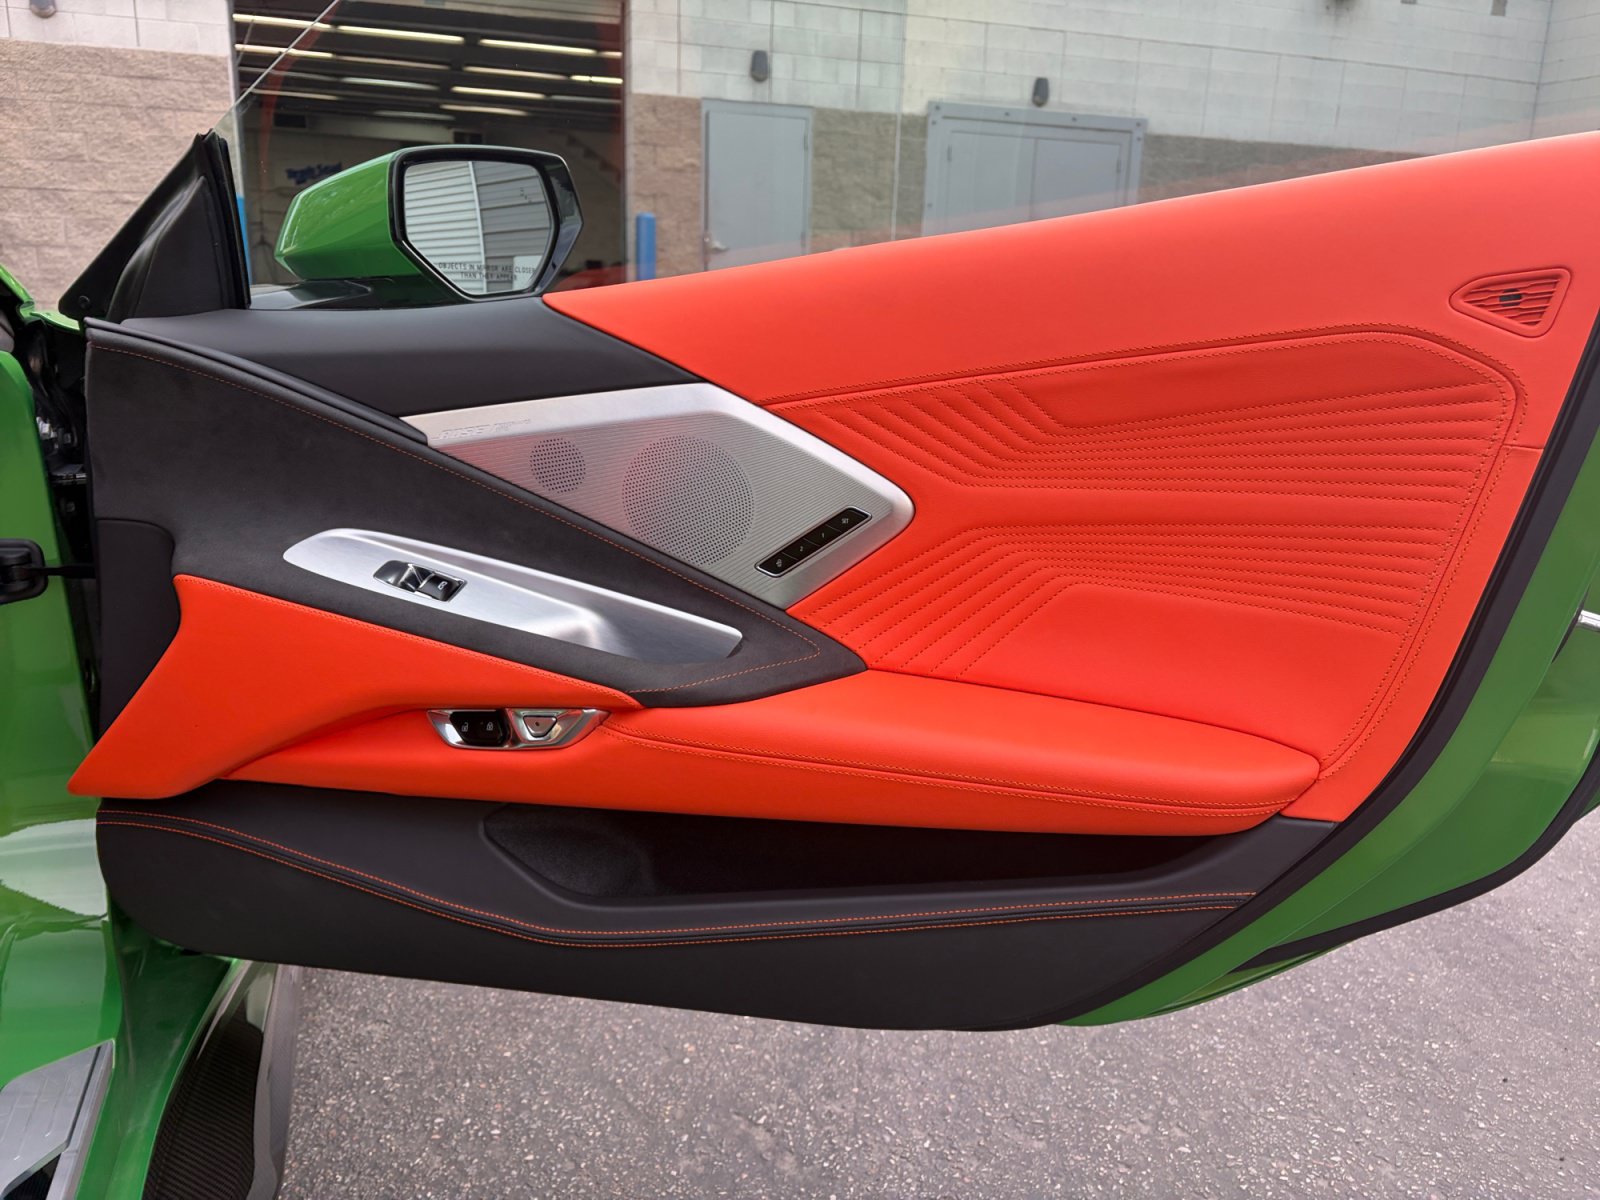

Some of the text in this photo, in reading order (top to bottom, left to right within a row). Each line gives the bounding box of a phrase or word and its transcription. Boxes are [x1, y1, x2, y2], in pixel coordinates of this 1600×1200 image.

[438, 262, 467, 271] OBJECTS
[468, 263, 475, 271] IN
[477, 264, 500, 272] MIRROR
[501, 265, 513, 273] ARE
[478, 272, 495, 280] THEY
[496, 273, 518, 281] APPEAR
